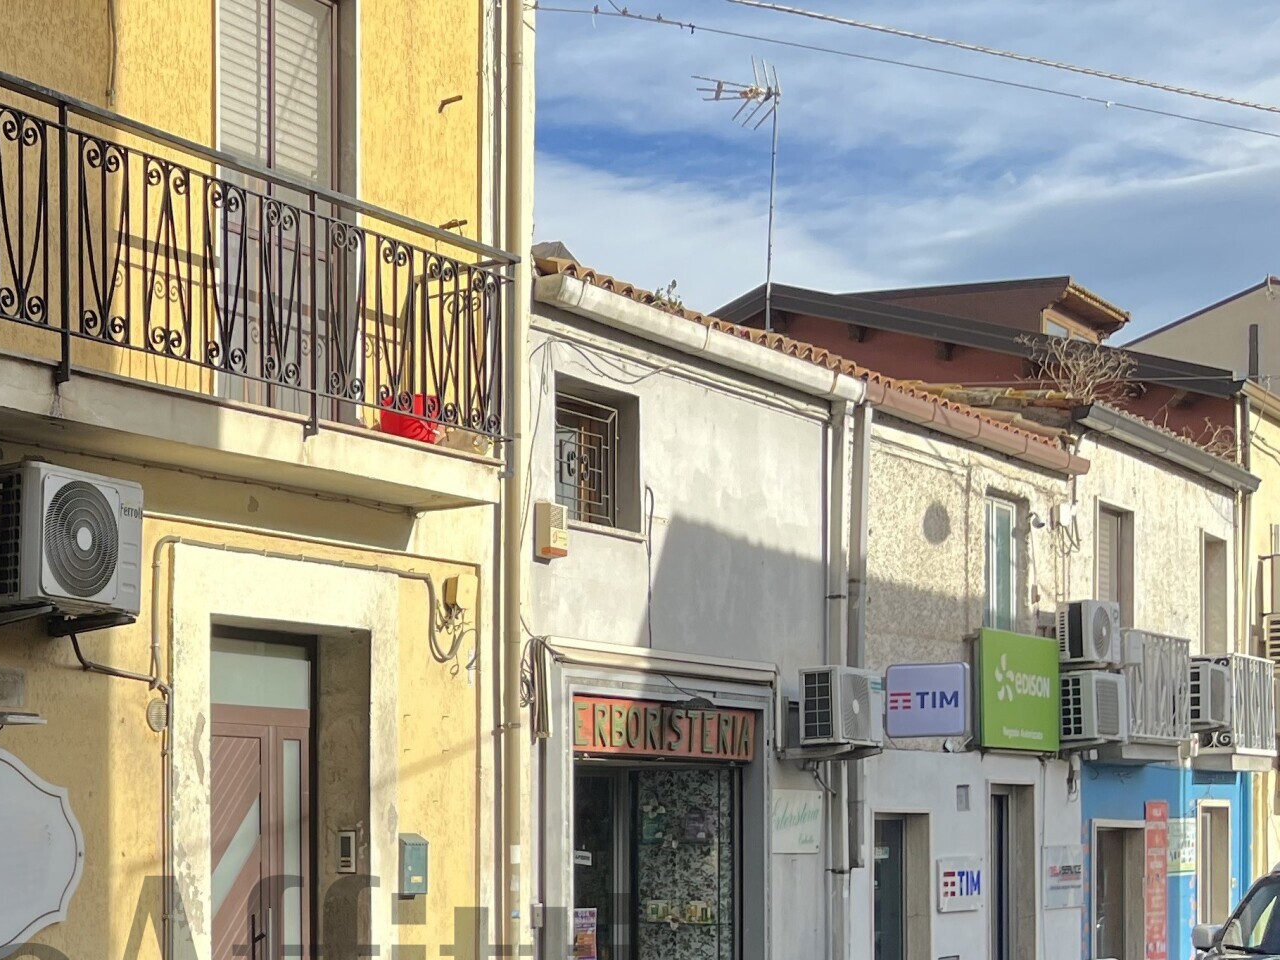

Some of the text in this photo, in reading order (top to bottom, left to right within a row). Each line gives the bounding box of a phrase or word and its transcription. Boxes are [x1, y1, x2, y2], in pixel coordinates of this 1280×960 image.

[915, 690, 959, 709] TIM
[572, 700, 751, 757] ERBORISTERIA
[957, 870, 981, 896] TIM
